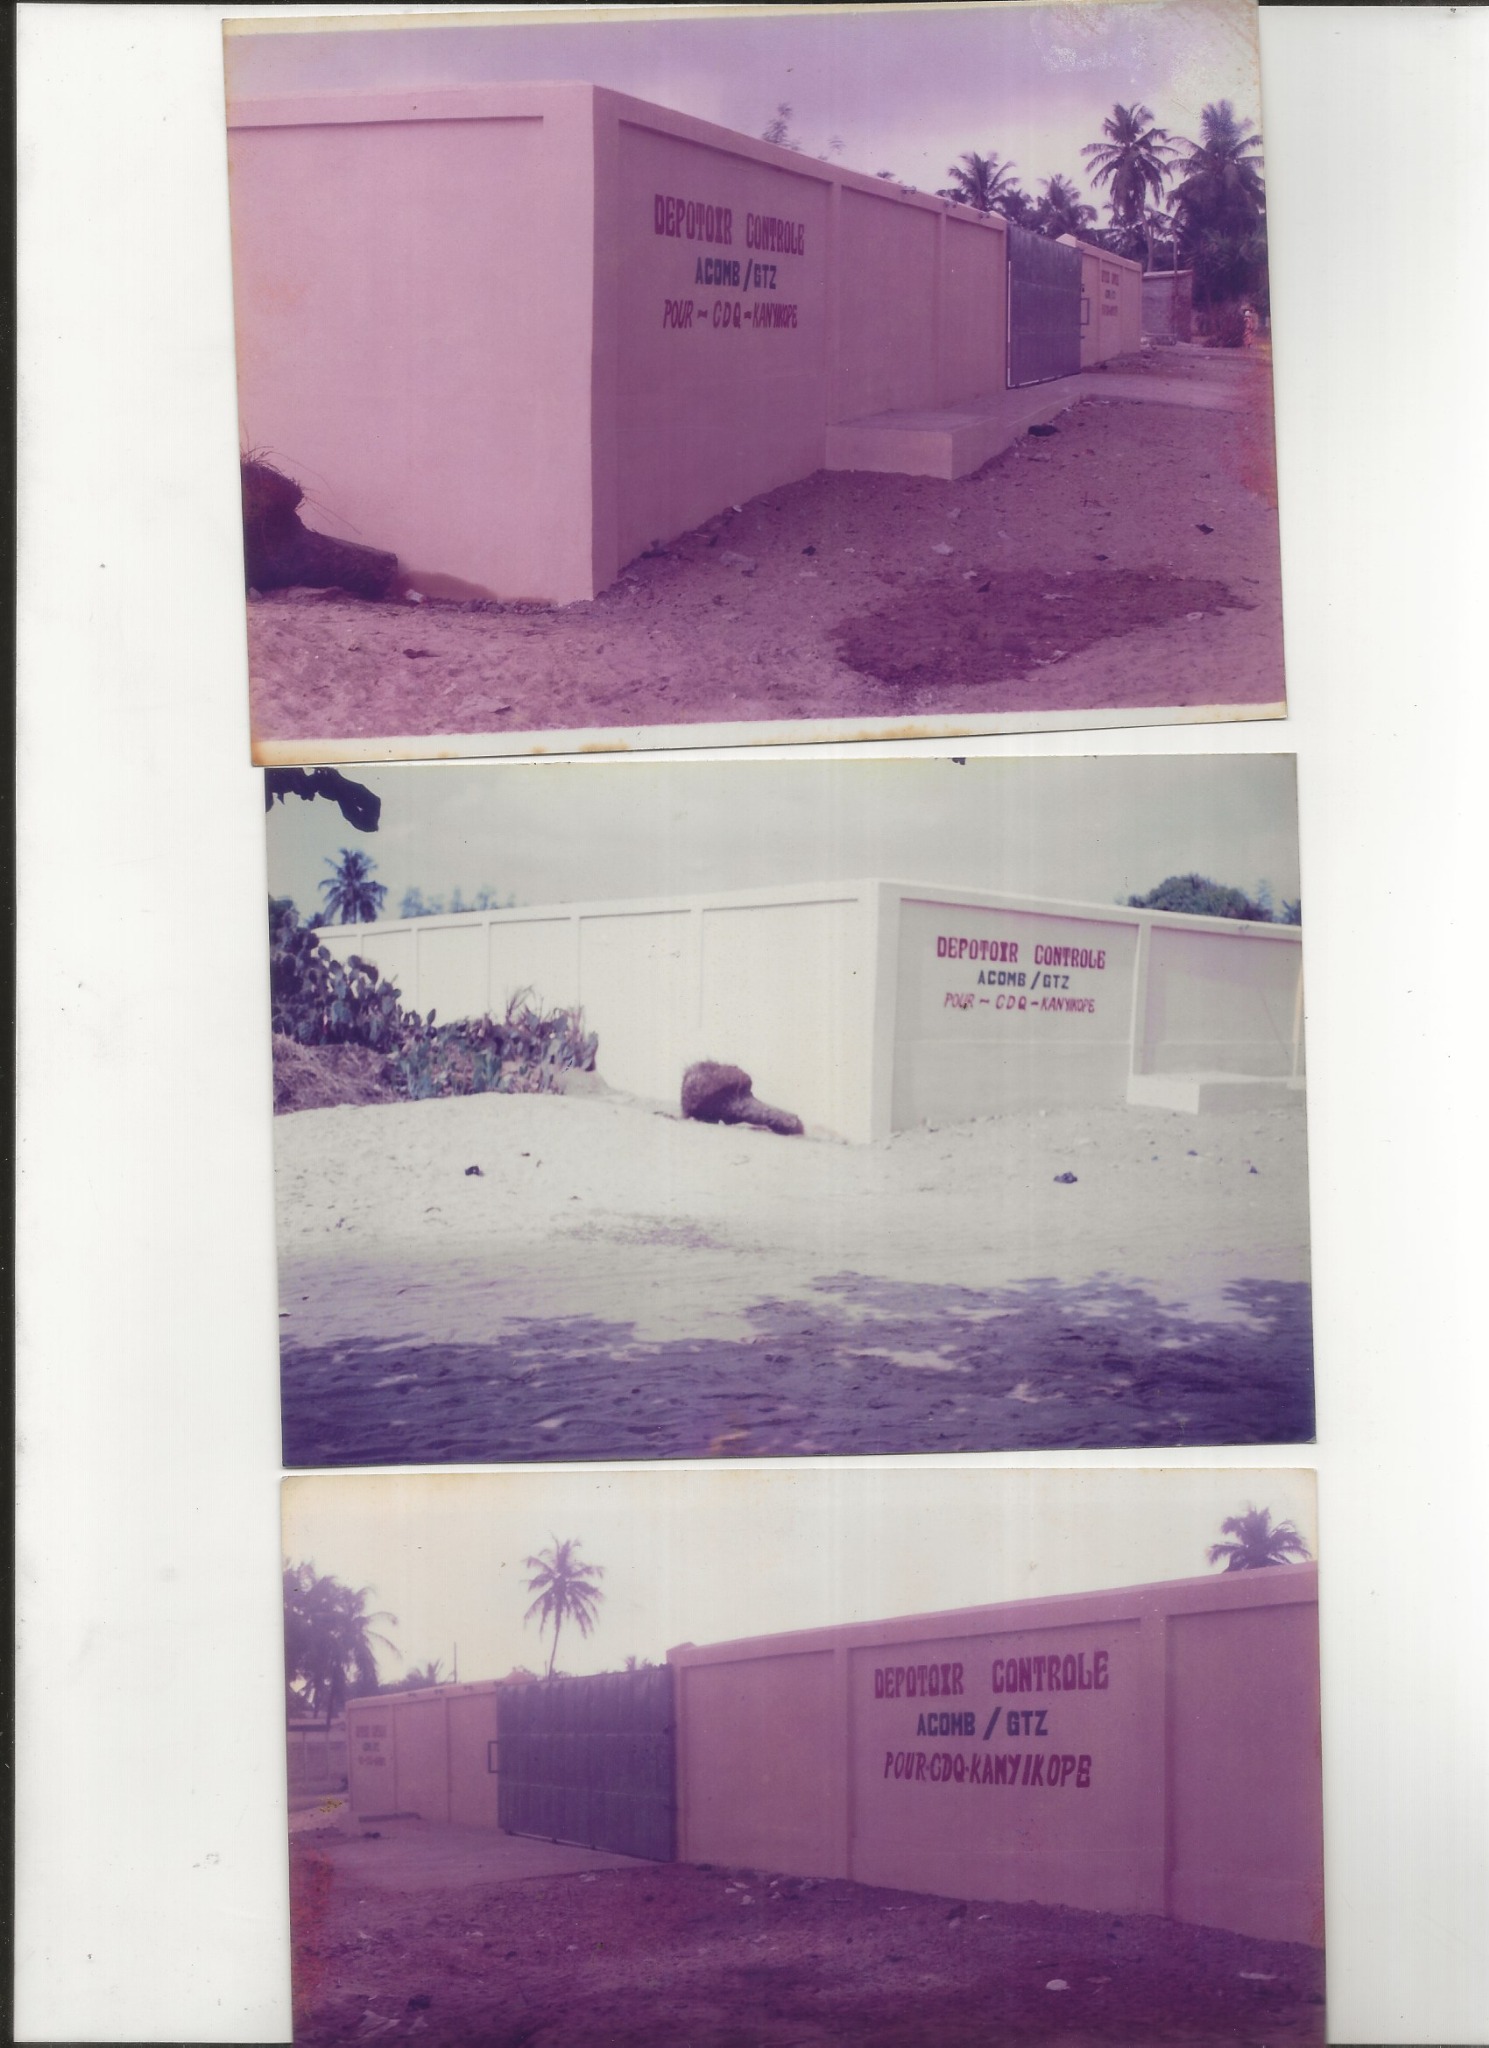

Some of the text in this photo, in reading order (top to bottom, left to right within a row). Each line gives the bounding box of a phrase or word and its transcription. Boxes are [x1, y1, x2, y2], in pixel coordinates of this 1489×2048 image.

[654, 193, 805, 256] DEPOTOIR CONTROLE
[662, 299, 694, 329] POUR
[936, 936, 1106, 970] DEPOTOIR CONTROLE
[874, 1650, 1109, 1699] DEPOTOIR CONTROLE
[916, 1711, 976, 1737] ACOMB
